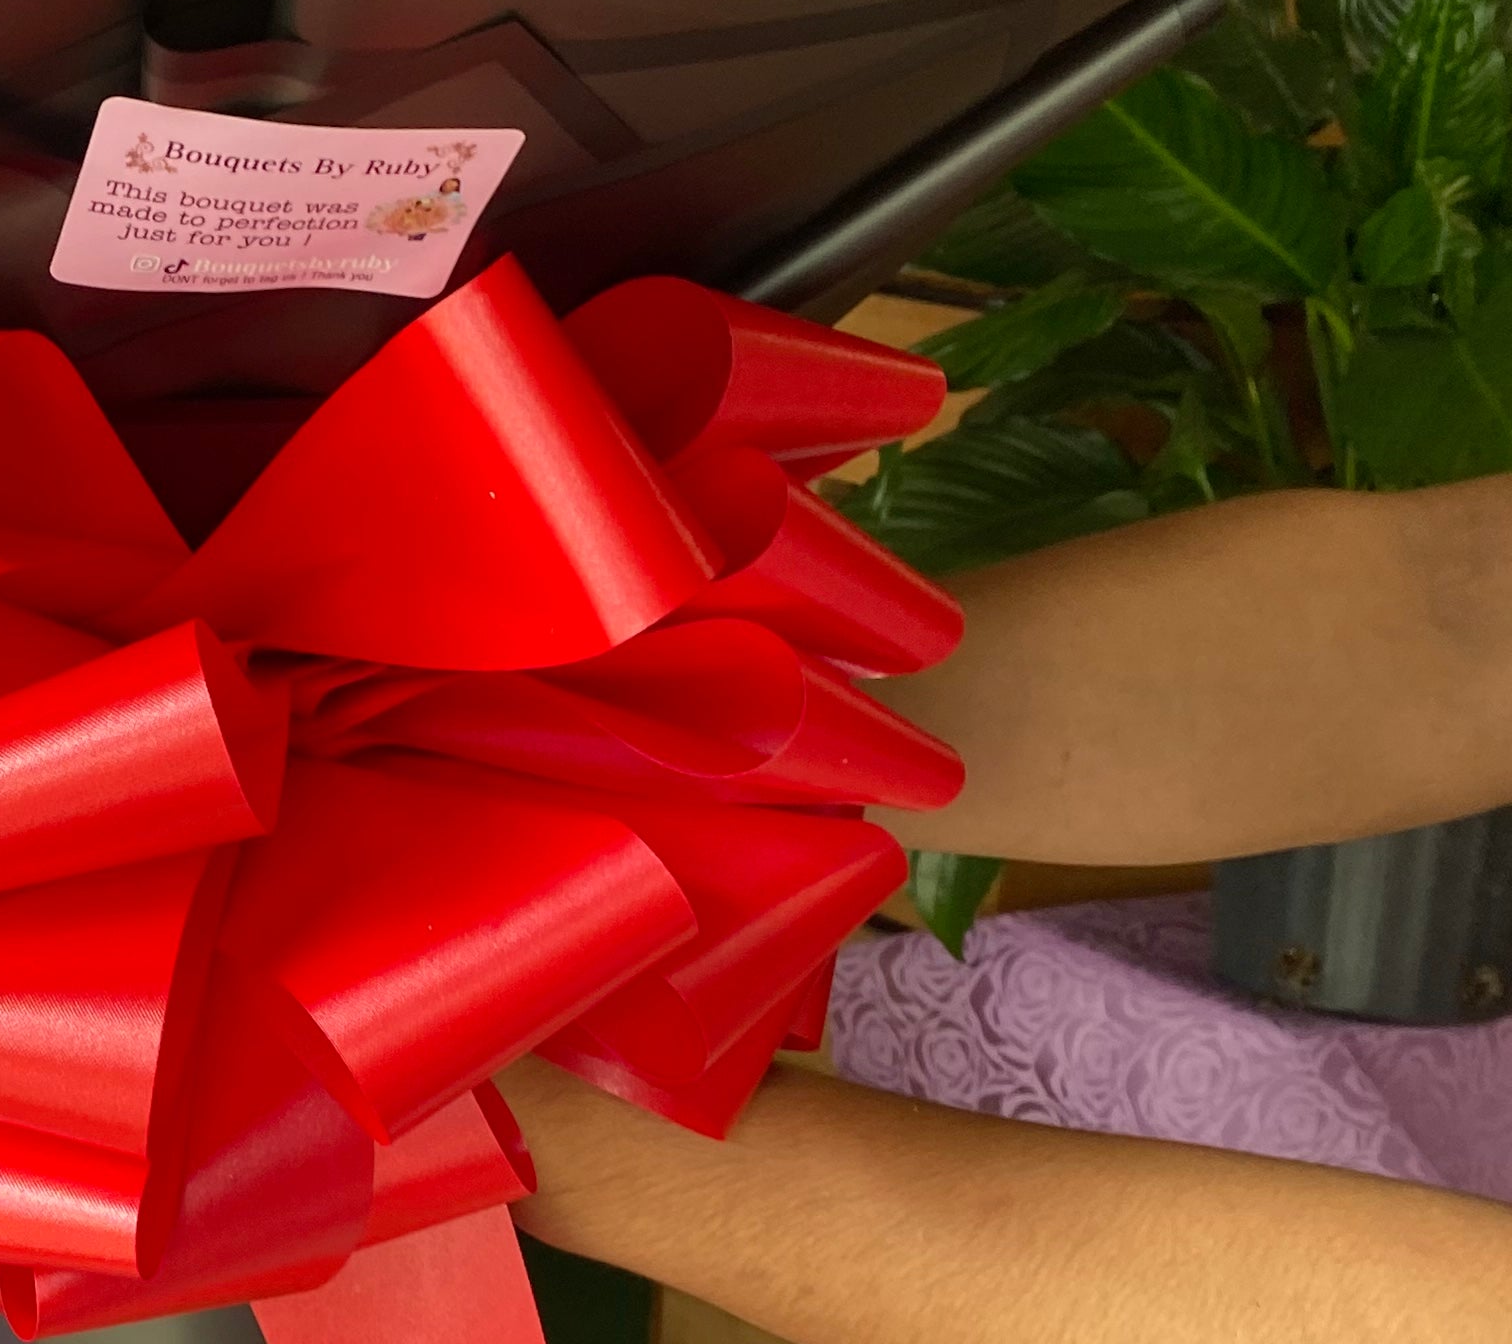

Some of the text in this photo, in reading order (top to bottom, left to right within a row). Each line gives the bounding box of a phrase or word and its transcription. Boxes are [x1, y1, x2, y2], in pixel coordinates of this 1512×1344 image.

[164, 140, 440, 180] Bouquets By Ruby
[106, 179, 360, 215] This bouquet was
[87, 199, 359, 232] made to perfection
[117, 222, 177, 243] just
[187, 229, 232, 247] for
[236, 233, 292, 249] you
[202, 274, 239, 286] forget
[242, 275, 256, 285] to
[310, 269, 346, 281] Thank
[350, 271, 374, 283] you
